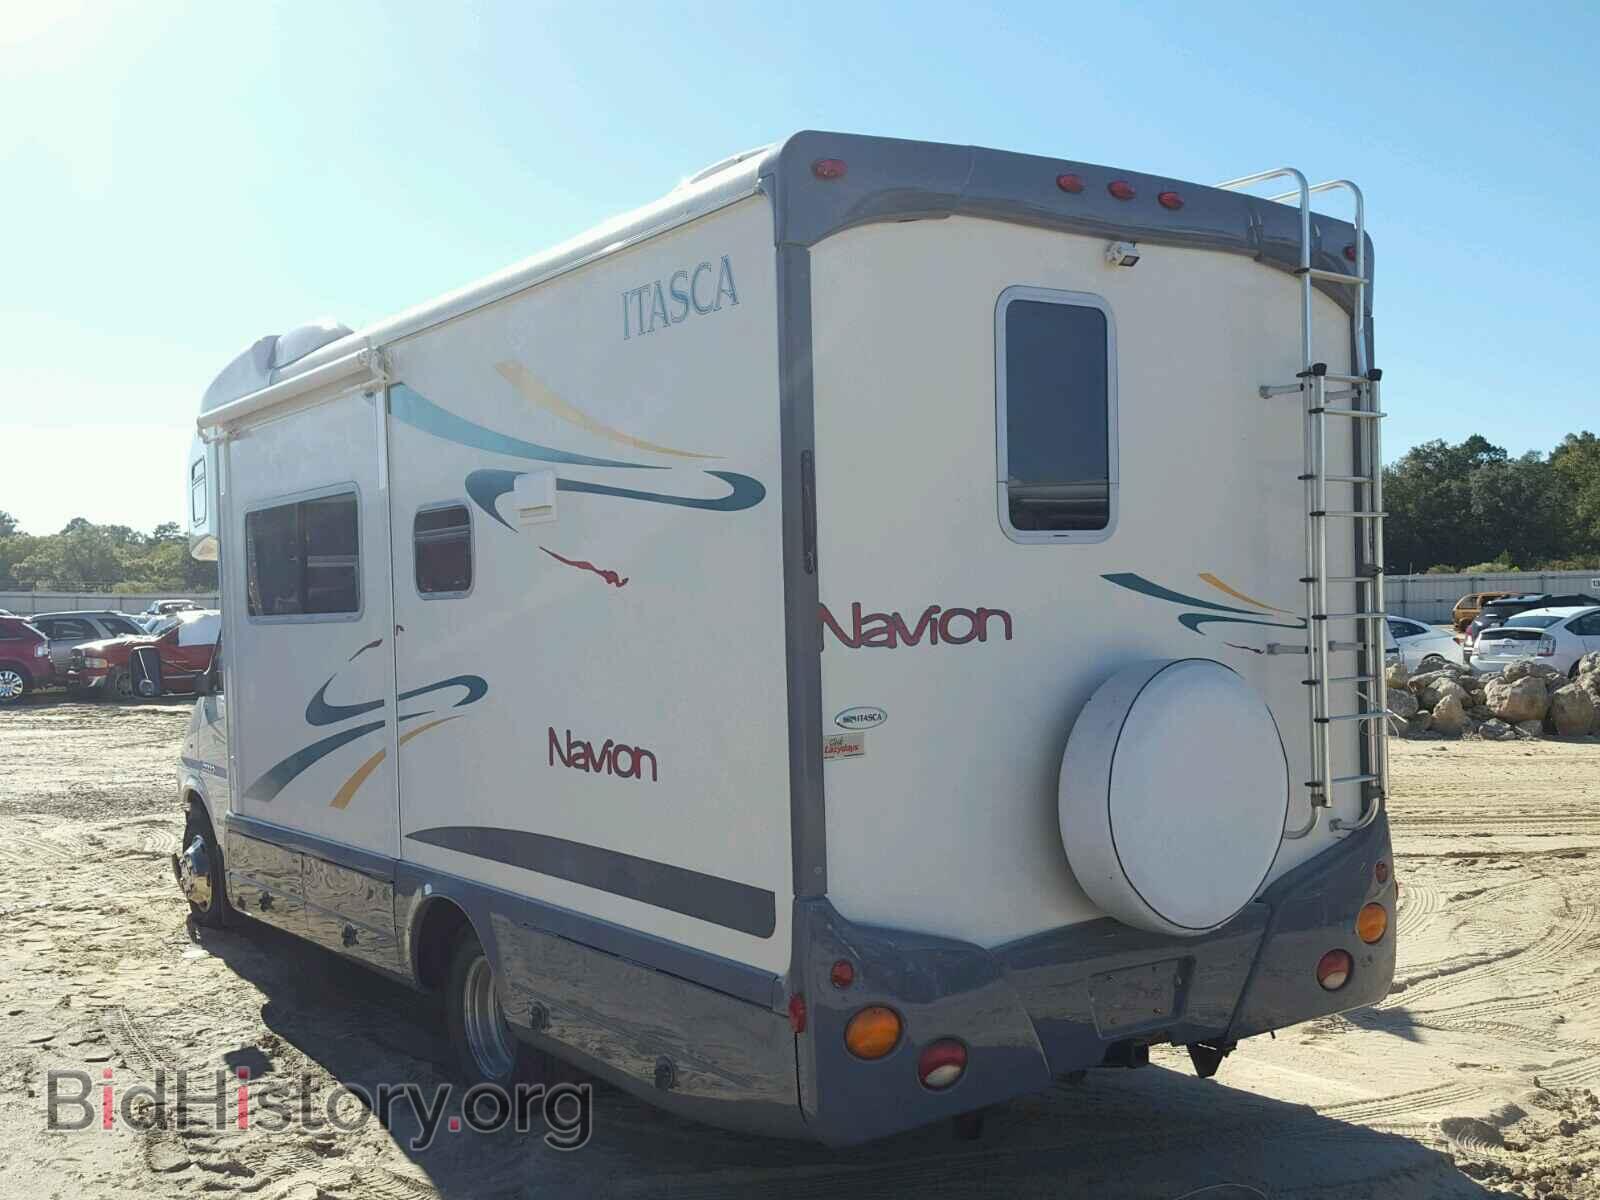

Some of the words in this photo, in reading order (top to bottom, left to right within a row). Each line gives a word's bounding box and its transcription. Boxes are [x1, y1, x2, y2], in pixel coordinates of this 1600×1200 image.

[622, 254, 740, 341] ITASCA
[816, 601, 1013, 652] Navion
[548, 726, 658, 782] Navion
